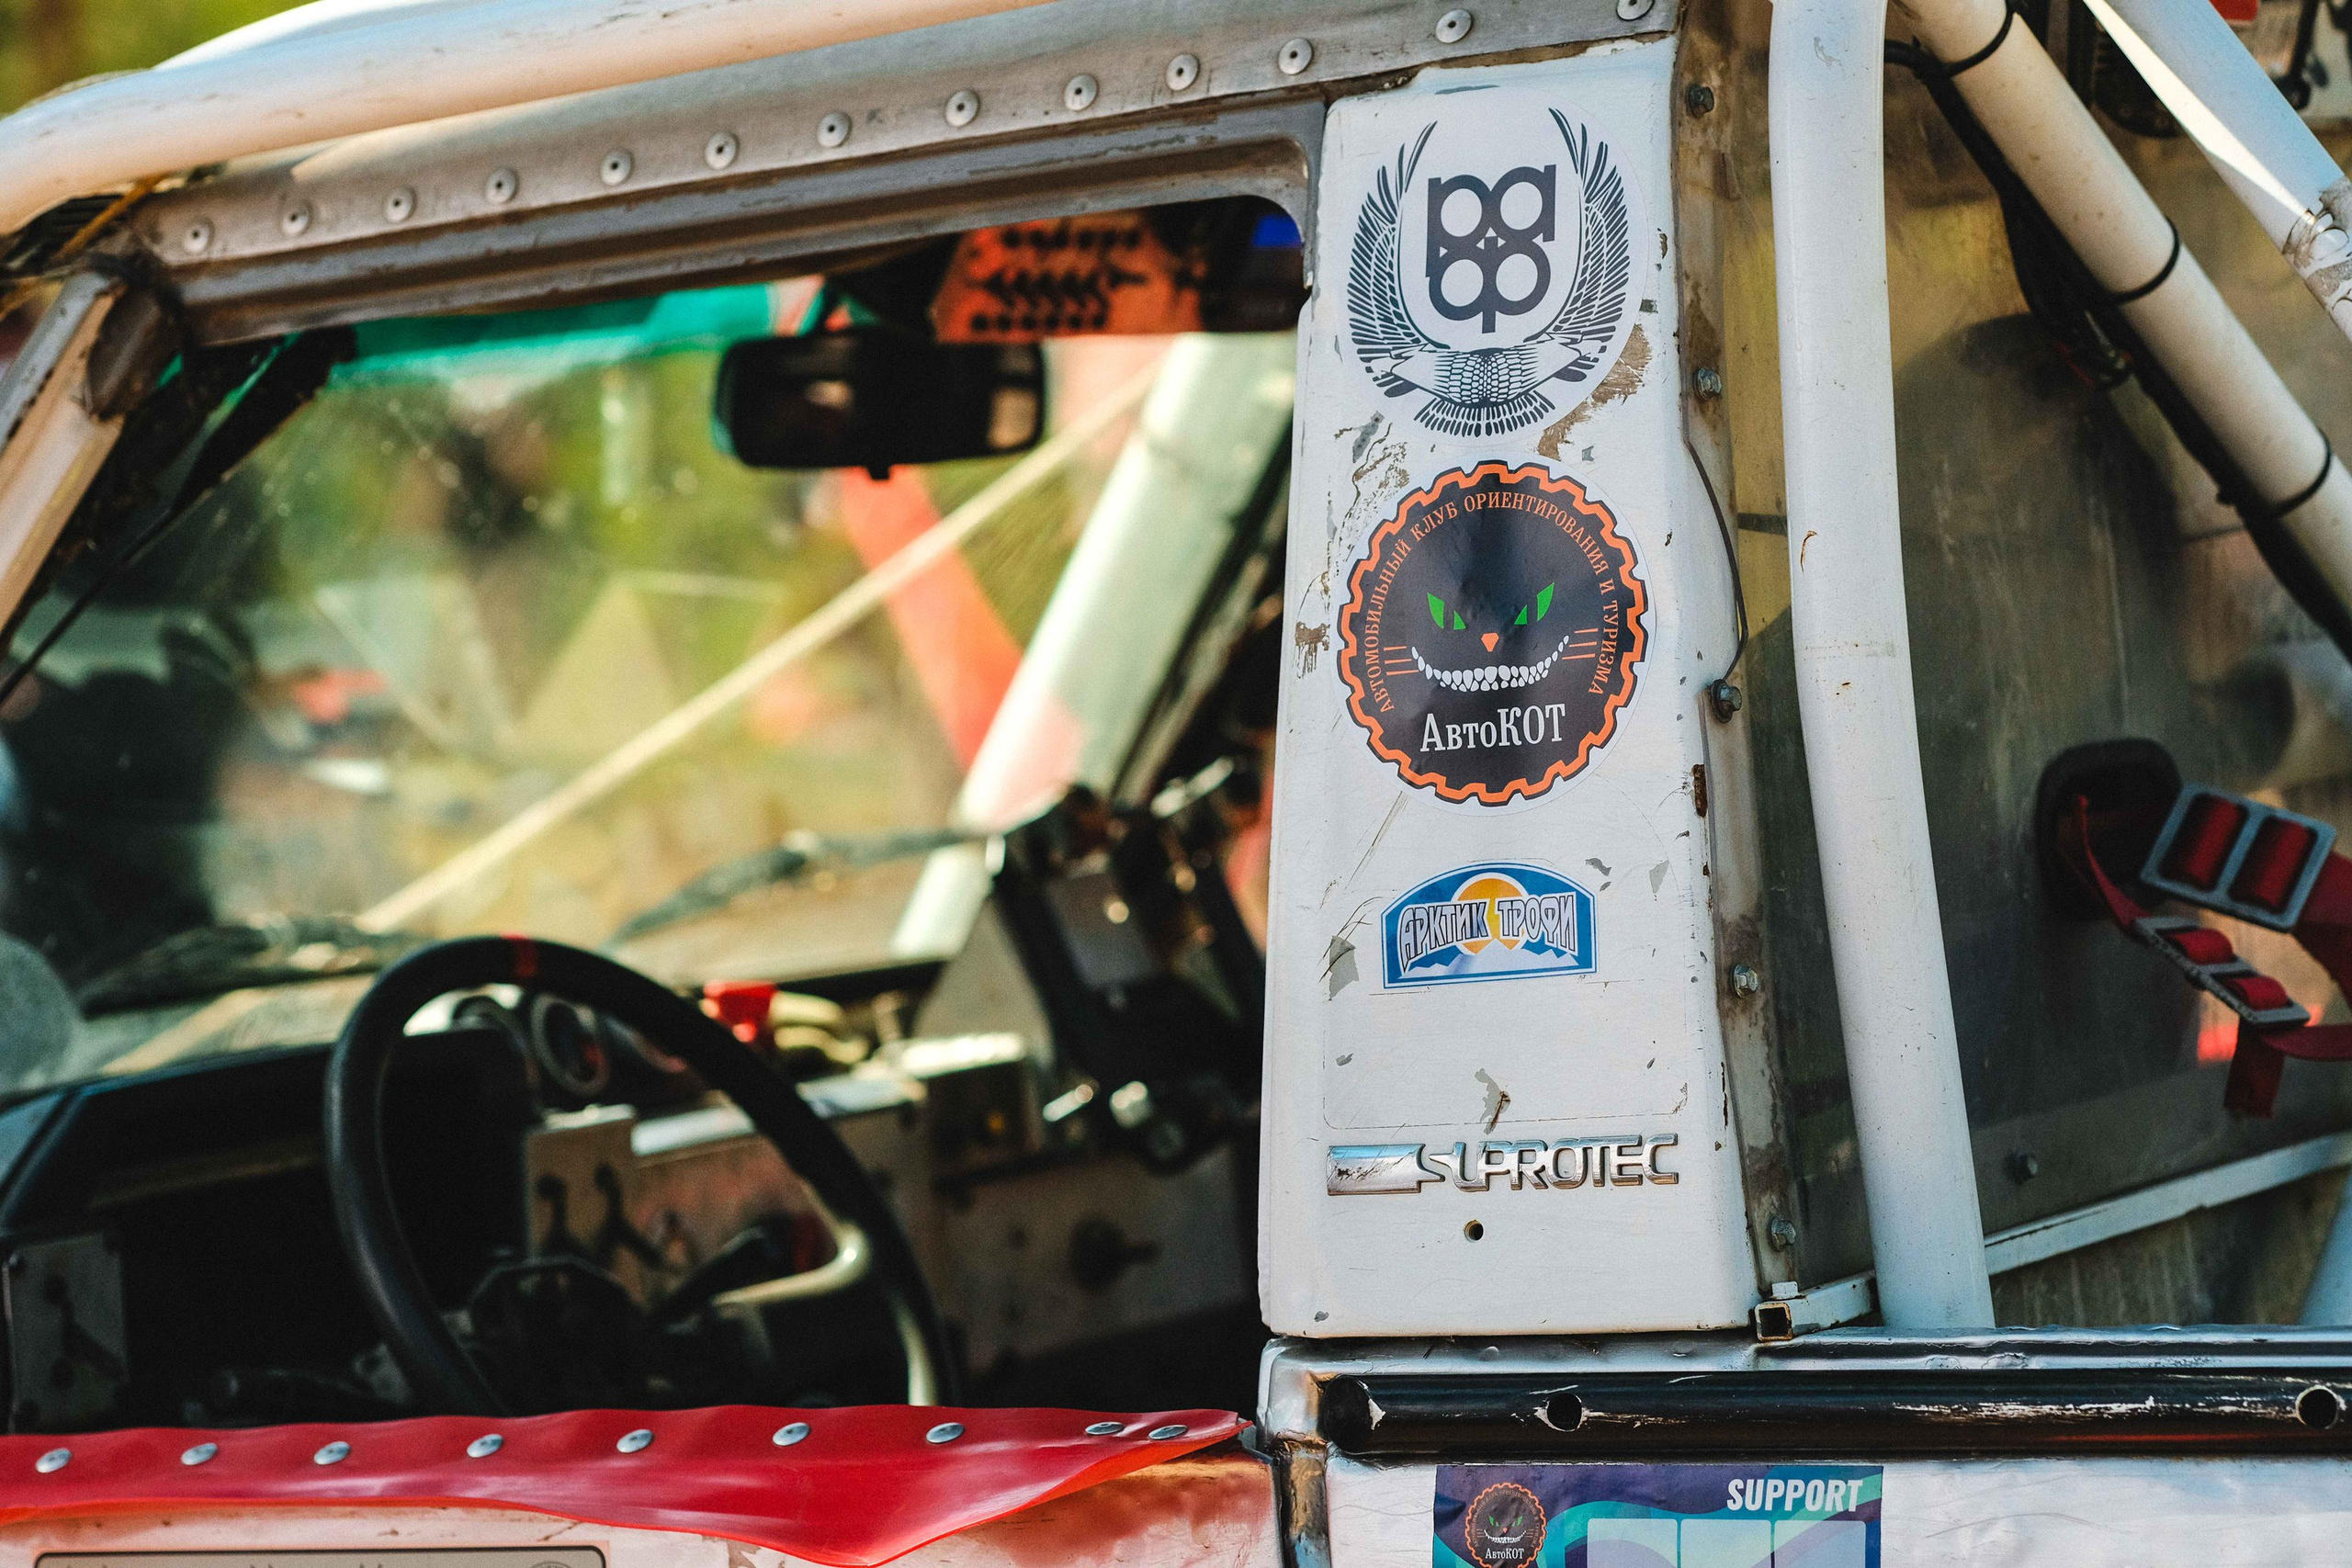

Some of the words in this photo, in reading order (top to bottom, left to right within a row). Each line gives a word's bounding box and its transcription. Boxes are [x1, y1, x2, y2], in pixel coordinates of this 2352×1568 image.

[1409, 501, 1459, 542] КЛУБ
[1464, 491, 1609, 575] ОРИЕНТИРОВАНИЯ
[1599, 578, 1615, 595] И
[1363, 538, 1412, 714] АВТОМОБИЛЬНЫЙ
[1589, 599, 1619, 695] ТУРИЗМА
[1419, 703, 1566, 752] АвтоКОТ
[1399, 899, 1489, 973] АРКТИК
[1498, 894, 1577, 953] ТРОФИ
[1417, 1133, 1679, 1193] SUPROTEC
[1726, 1478, 1863, 1513] SUPPORT
